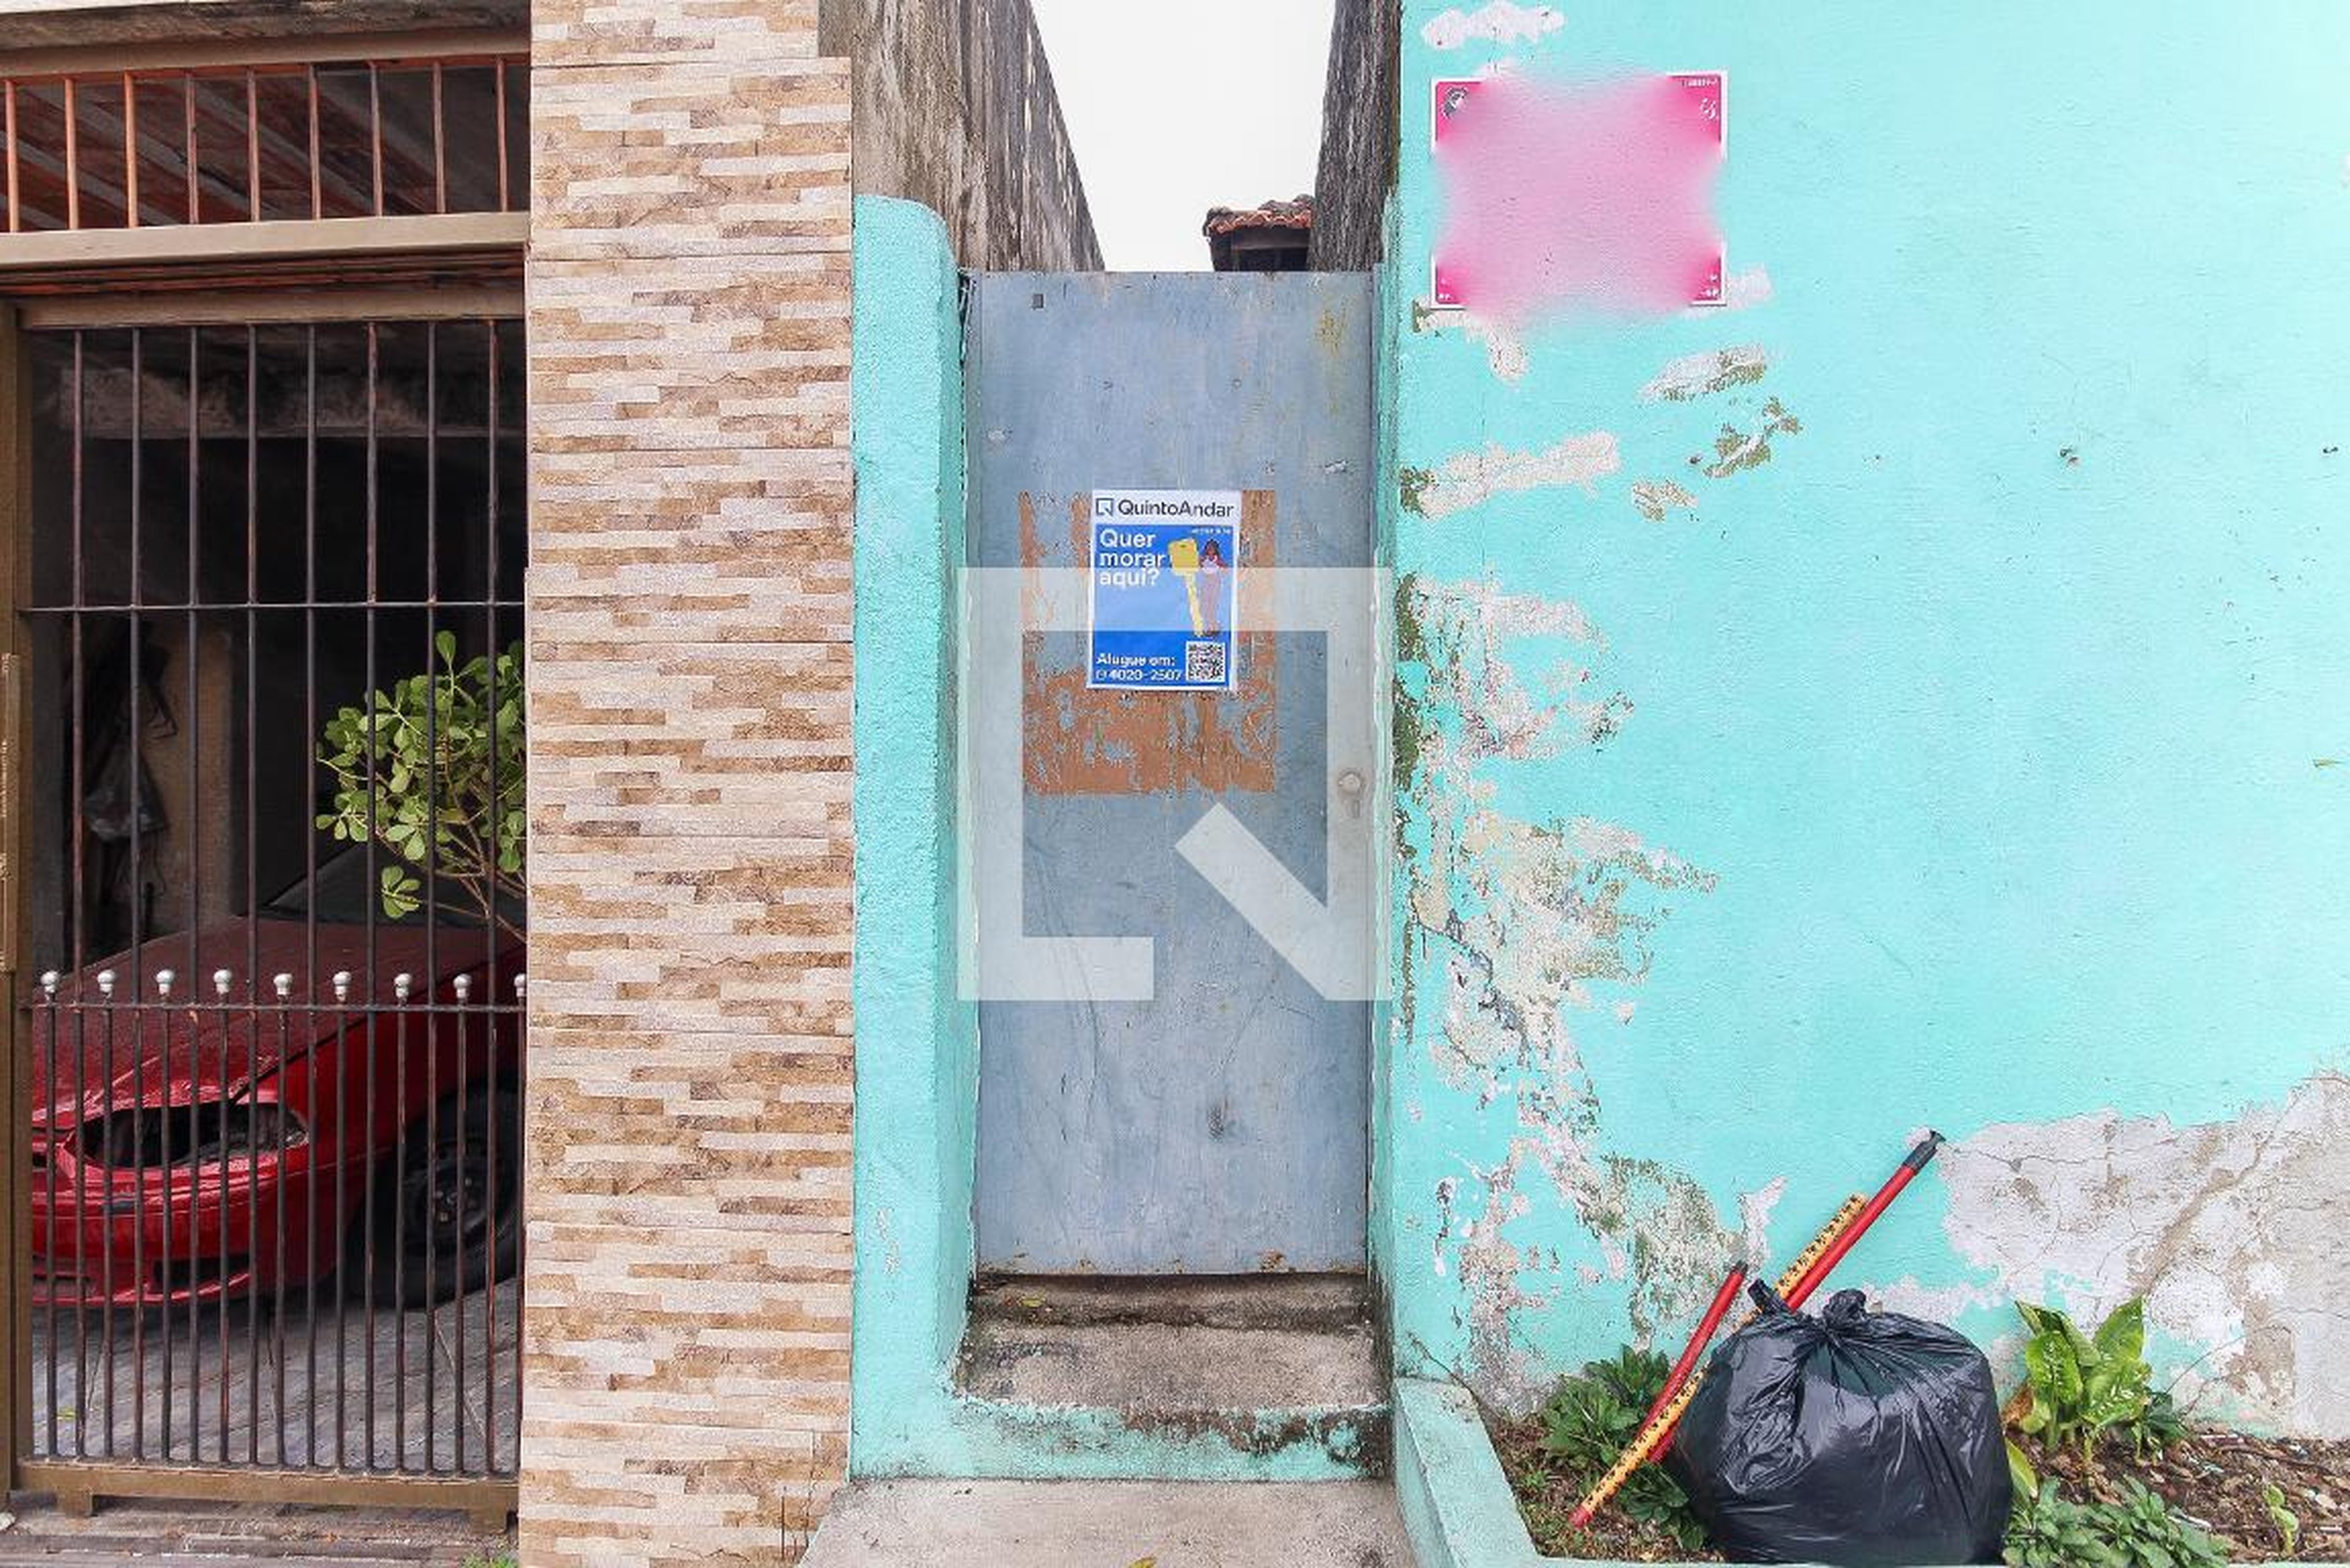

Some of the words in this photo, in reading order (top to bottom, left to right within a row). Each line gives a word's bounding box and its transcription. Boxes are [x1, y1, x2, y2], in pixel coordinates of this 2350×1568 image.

[1118, 499, 1234, 517] QuintoAndar
[1100, 529, 1155, 548] Quer
[1099, 552, 1166, 567] morar
[1099, 568, 1160, 588] aqui?
[1096, 653, 1146, 668] Alugue
[1149, 656, 1176, 666] em:
[1109, 669, 1182, 681] 4020-2507
